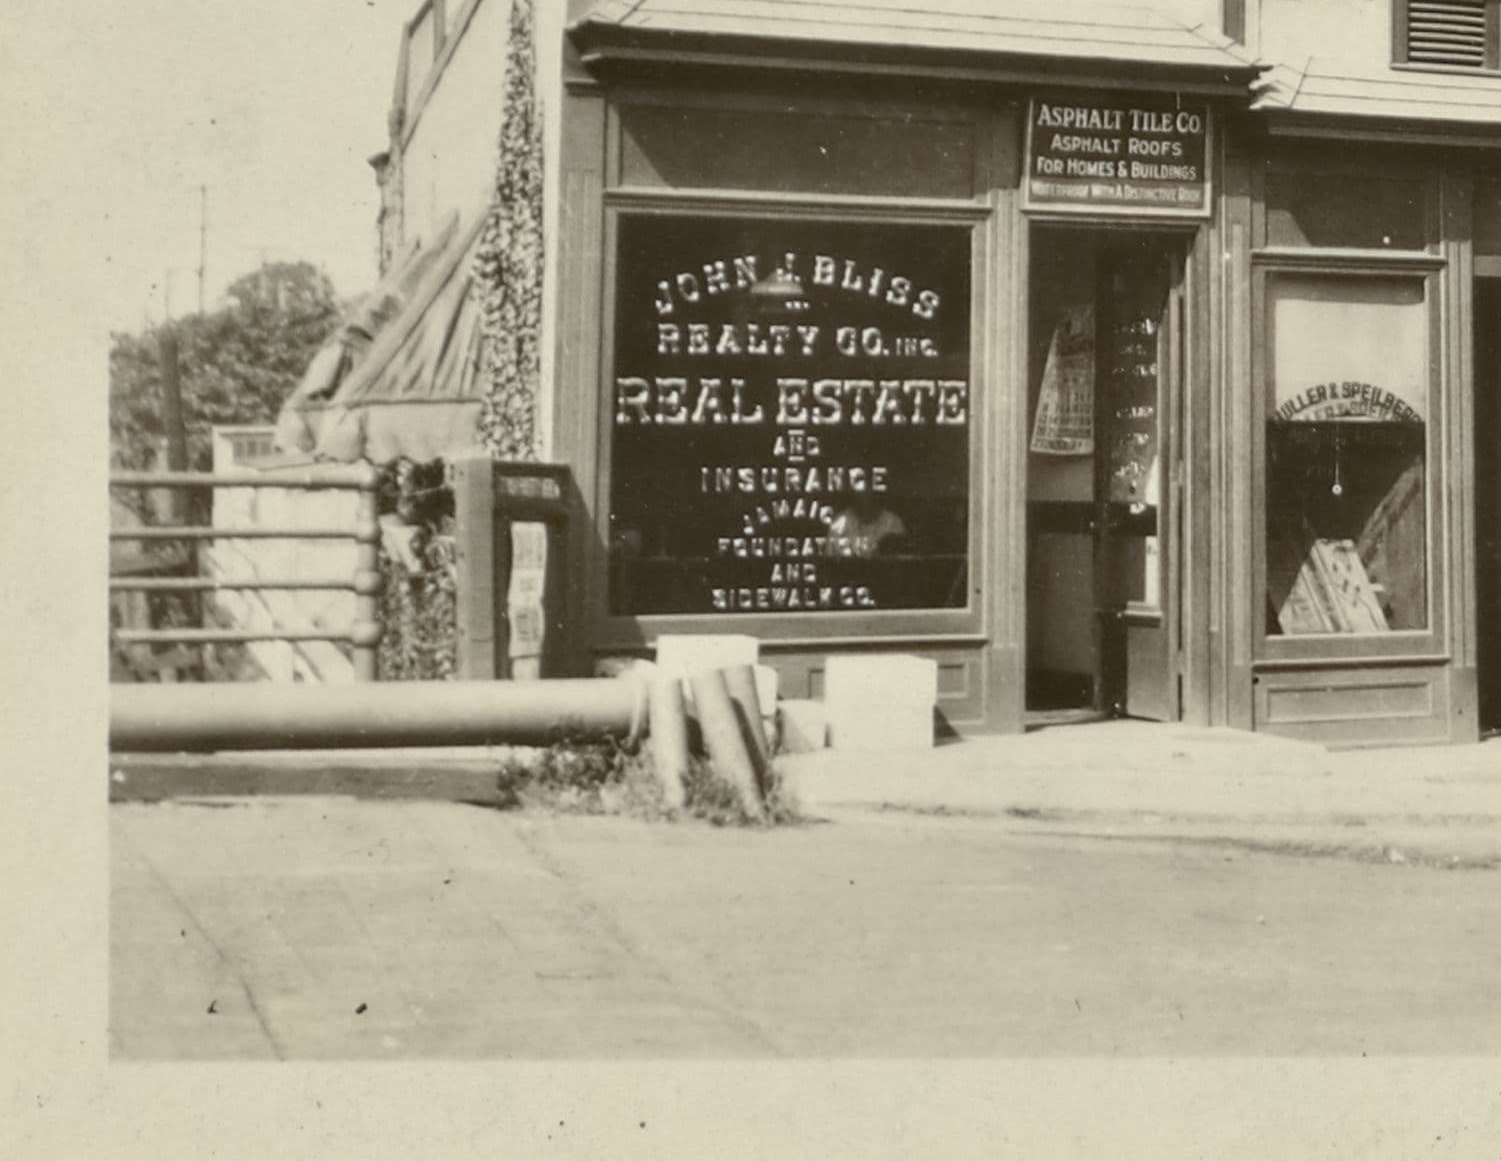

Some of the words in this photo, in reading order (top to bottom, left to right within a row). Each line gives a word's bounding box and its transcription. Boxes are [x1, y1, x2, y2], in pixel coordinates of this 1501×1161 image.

[1037, 103, 1124, 130] ASPHALT
[1129, 109, 1173, 132] TILE
[1050, 133, 1121, 154] ASPHALT
[1128, 137, 1182, 156] ROOFS
[1037, 156, 1064, 175] FOR
[1067, 158, 1115, 177] HOMES
[1117, 160, 1128, 178] &
[1131, 160, 1197, 181] BUILDINGS
[655, 255, 757, 315] JOHN
[813, 255, 940, 319] BLISS
[657, 323, 819, 355] REALTY
[836, 327, 890, 357] CO.
[896, 337, 939, 358] INC.
[616, 377, 764, 425] REAL
[776, 378, 967, 425] ESTATE
[773, 435, 820, 457] AND
[701, 467, 888, 493] INSURANCE
[743, 498, 847, 535] JAMAICA
[717, 537, 877, 557] FOUNDATION
[770, 563, 816, 583] AND
[711, 588, 832, 609] SIDEWALK
[839, 587, 876, 607] CO.
